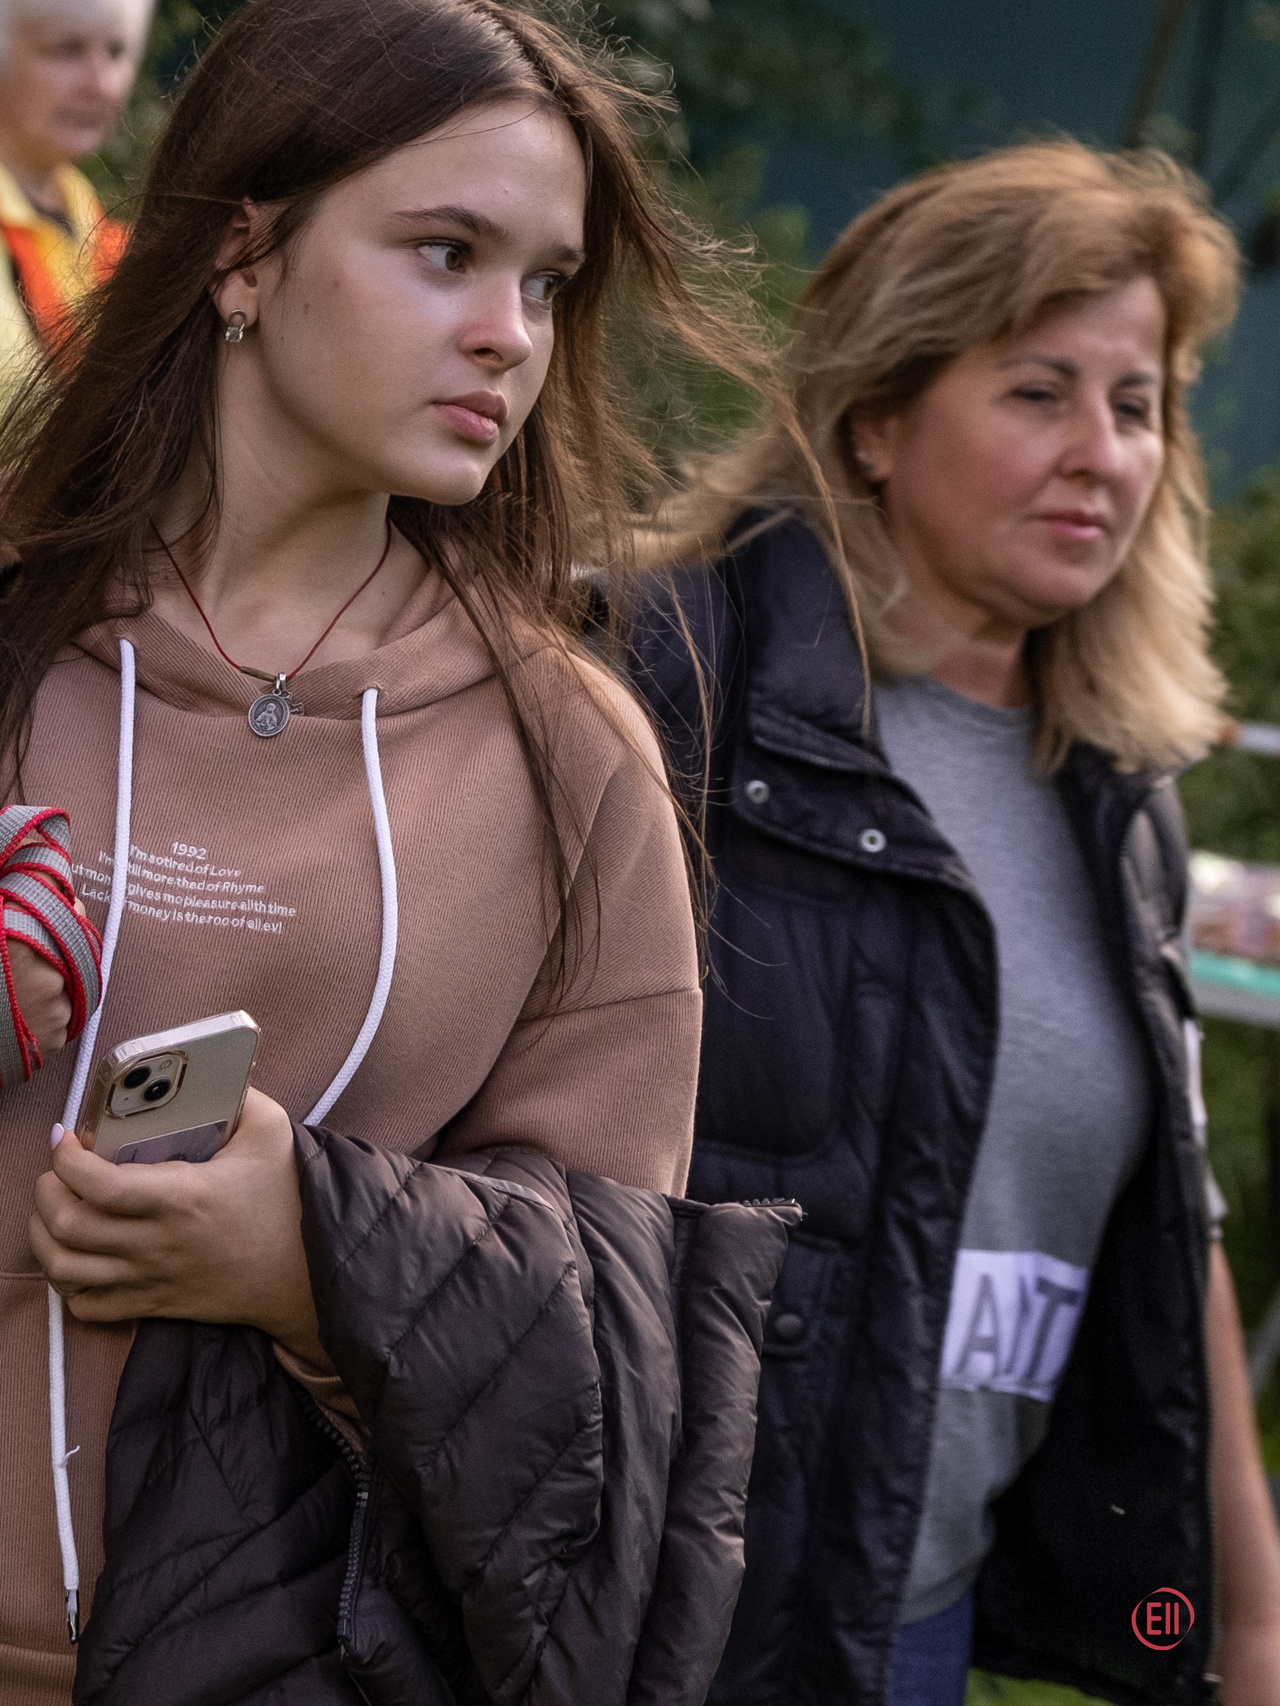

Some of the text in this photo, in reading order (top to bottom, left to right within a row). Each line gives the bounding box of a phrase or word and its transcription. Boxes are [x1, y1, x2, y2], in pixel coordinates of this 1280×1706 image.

[172, 841, 207, 860] 1992
[149, 854, 164, 866] so
[195, 863, 210, 874] of
[210, 864, 242, 877] Love
[142, 868, 175, 885] more
[206, 881, 222, 892] of
[222, 881, 265, 895] Rhyme
[127, 900, 171, 921] money
[183, 894, 238, 909] pleasure
